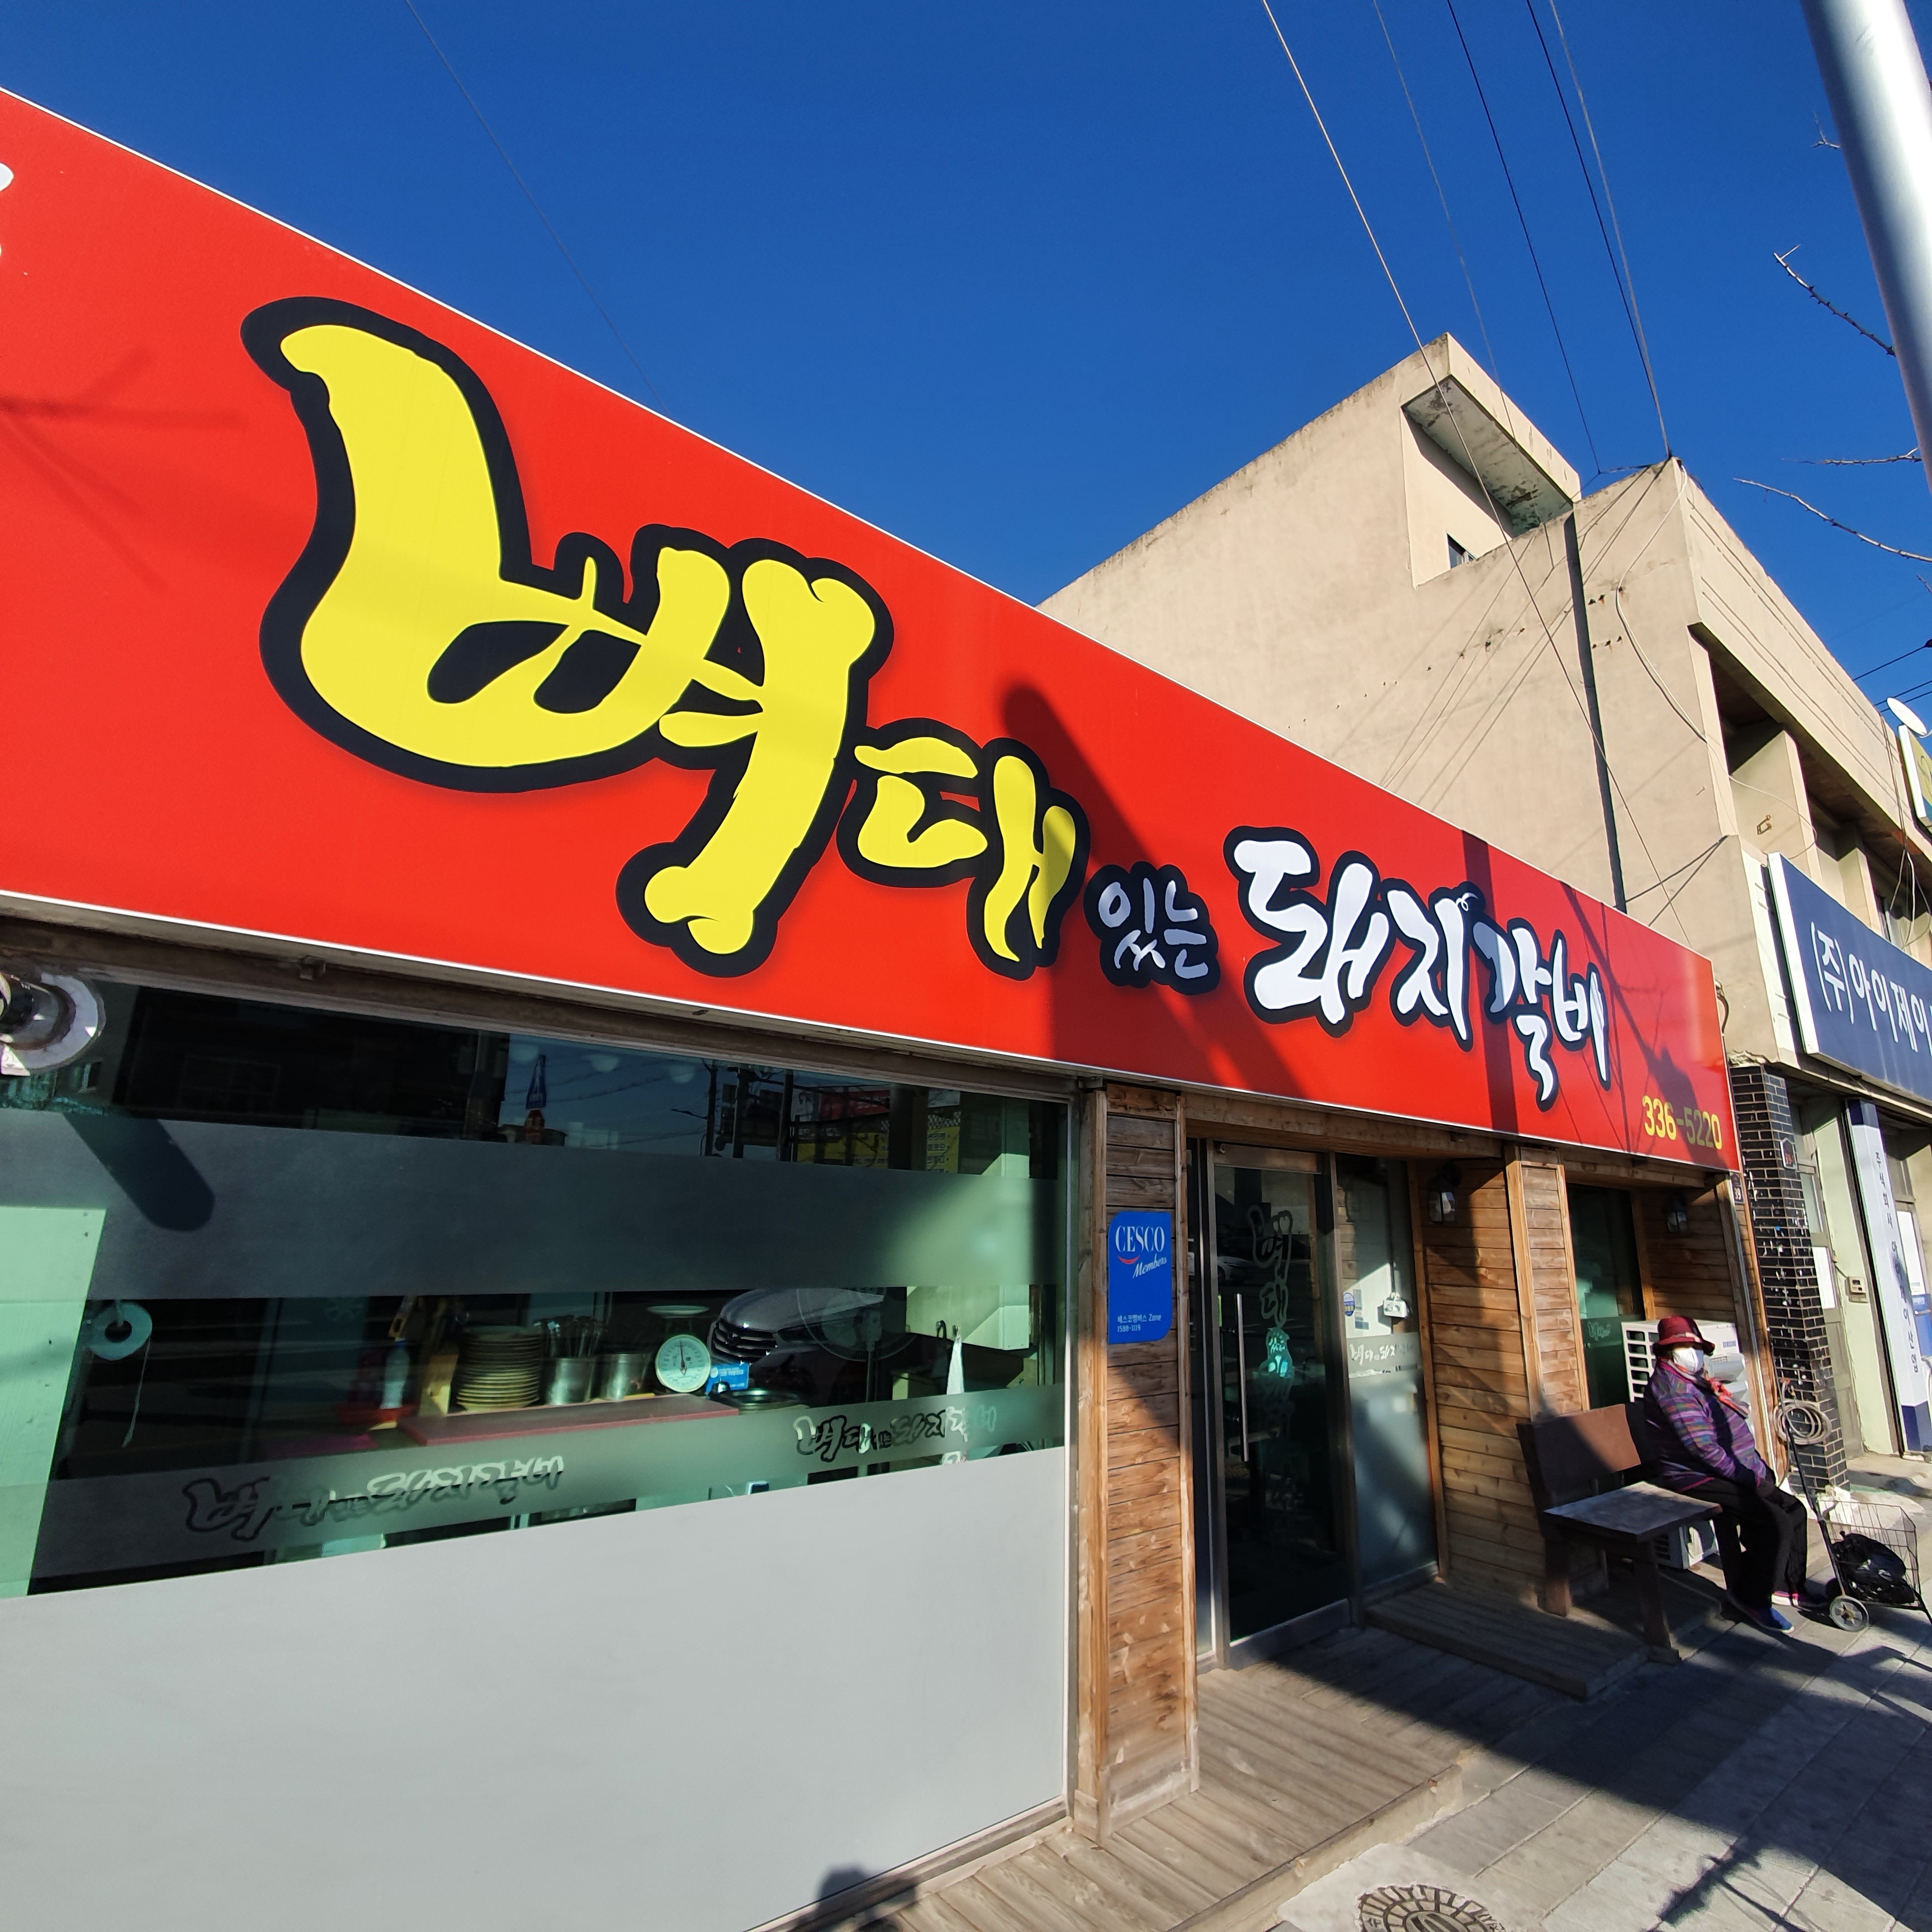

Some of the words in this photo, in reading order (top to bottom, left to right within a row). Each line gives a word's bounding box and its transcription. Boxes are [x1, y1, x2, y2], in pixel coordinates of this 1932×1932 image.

[280, 322, 1077, 964] 뼈대
[1097, 877, 1210, 981] 있는
[1233, 840, 1609, 1101] 돼지갈비
[1811, 921, 1932, 1058] (주)아이제이
[1642, 1095, 1722, 1150] 336-5220
[1115, 1225, 1165, 1252] CESCO
[1132, 1253, 1167, 1279] Members
